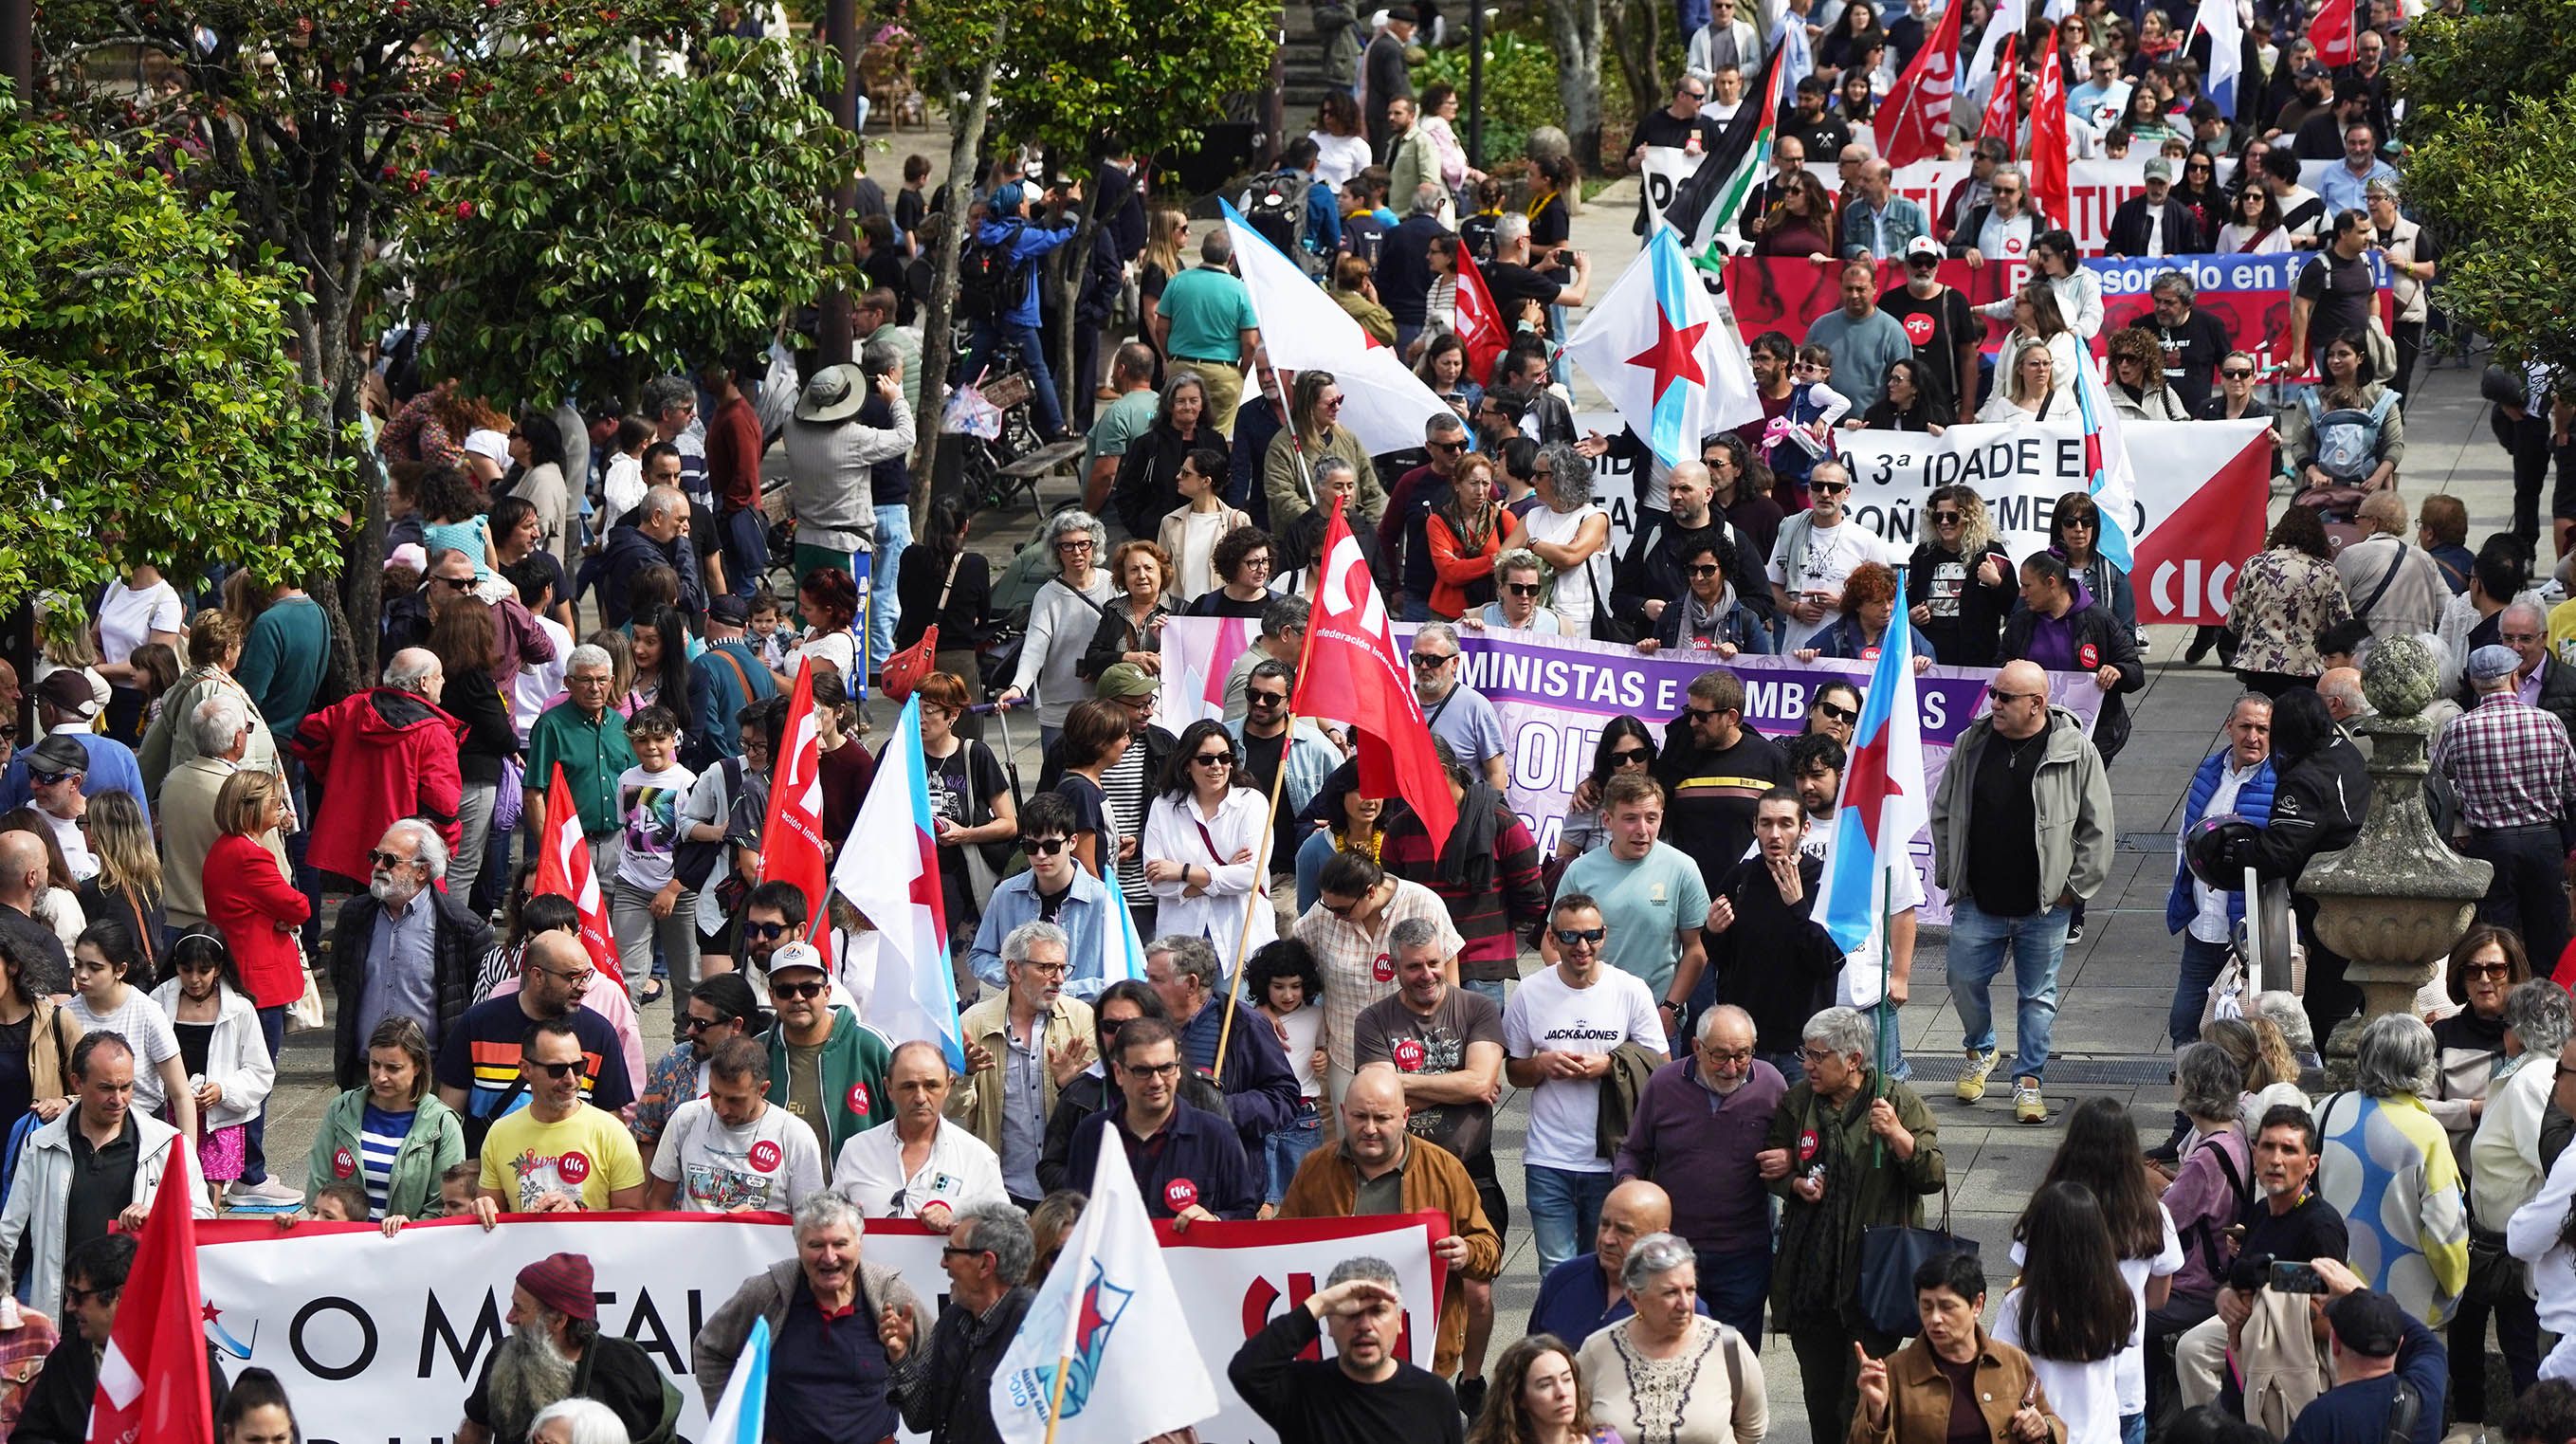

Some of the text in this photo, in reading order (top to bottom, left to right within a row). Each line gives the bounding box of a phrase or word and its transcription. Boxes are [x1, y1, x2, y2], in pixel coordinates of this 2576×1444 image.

[2232, 265, 2275, 290] en
[1923, 439, 2040, 487] IDADE
[1316, 628, 1371, 652] nfederación
[1409, 651, 1646, 707] MINISTAS
[1655, 680, 1677, 710] E
[1544, 1029, 1619, 1041] JACK&JONES
[564, 1157, 584, 1173] CIG
[757, 1145, 776, 1162] CIG
[1170, 1185, 1191, 1199] CIG
[289, 1295, 378, 1380] O
